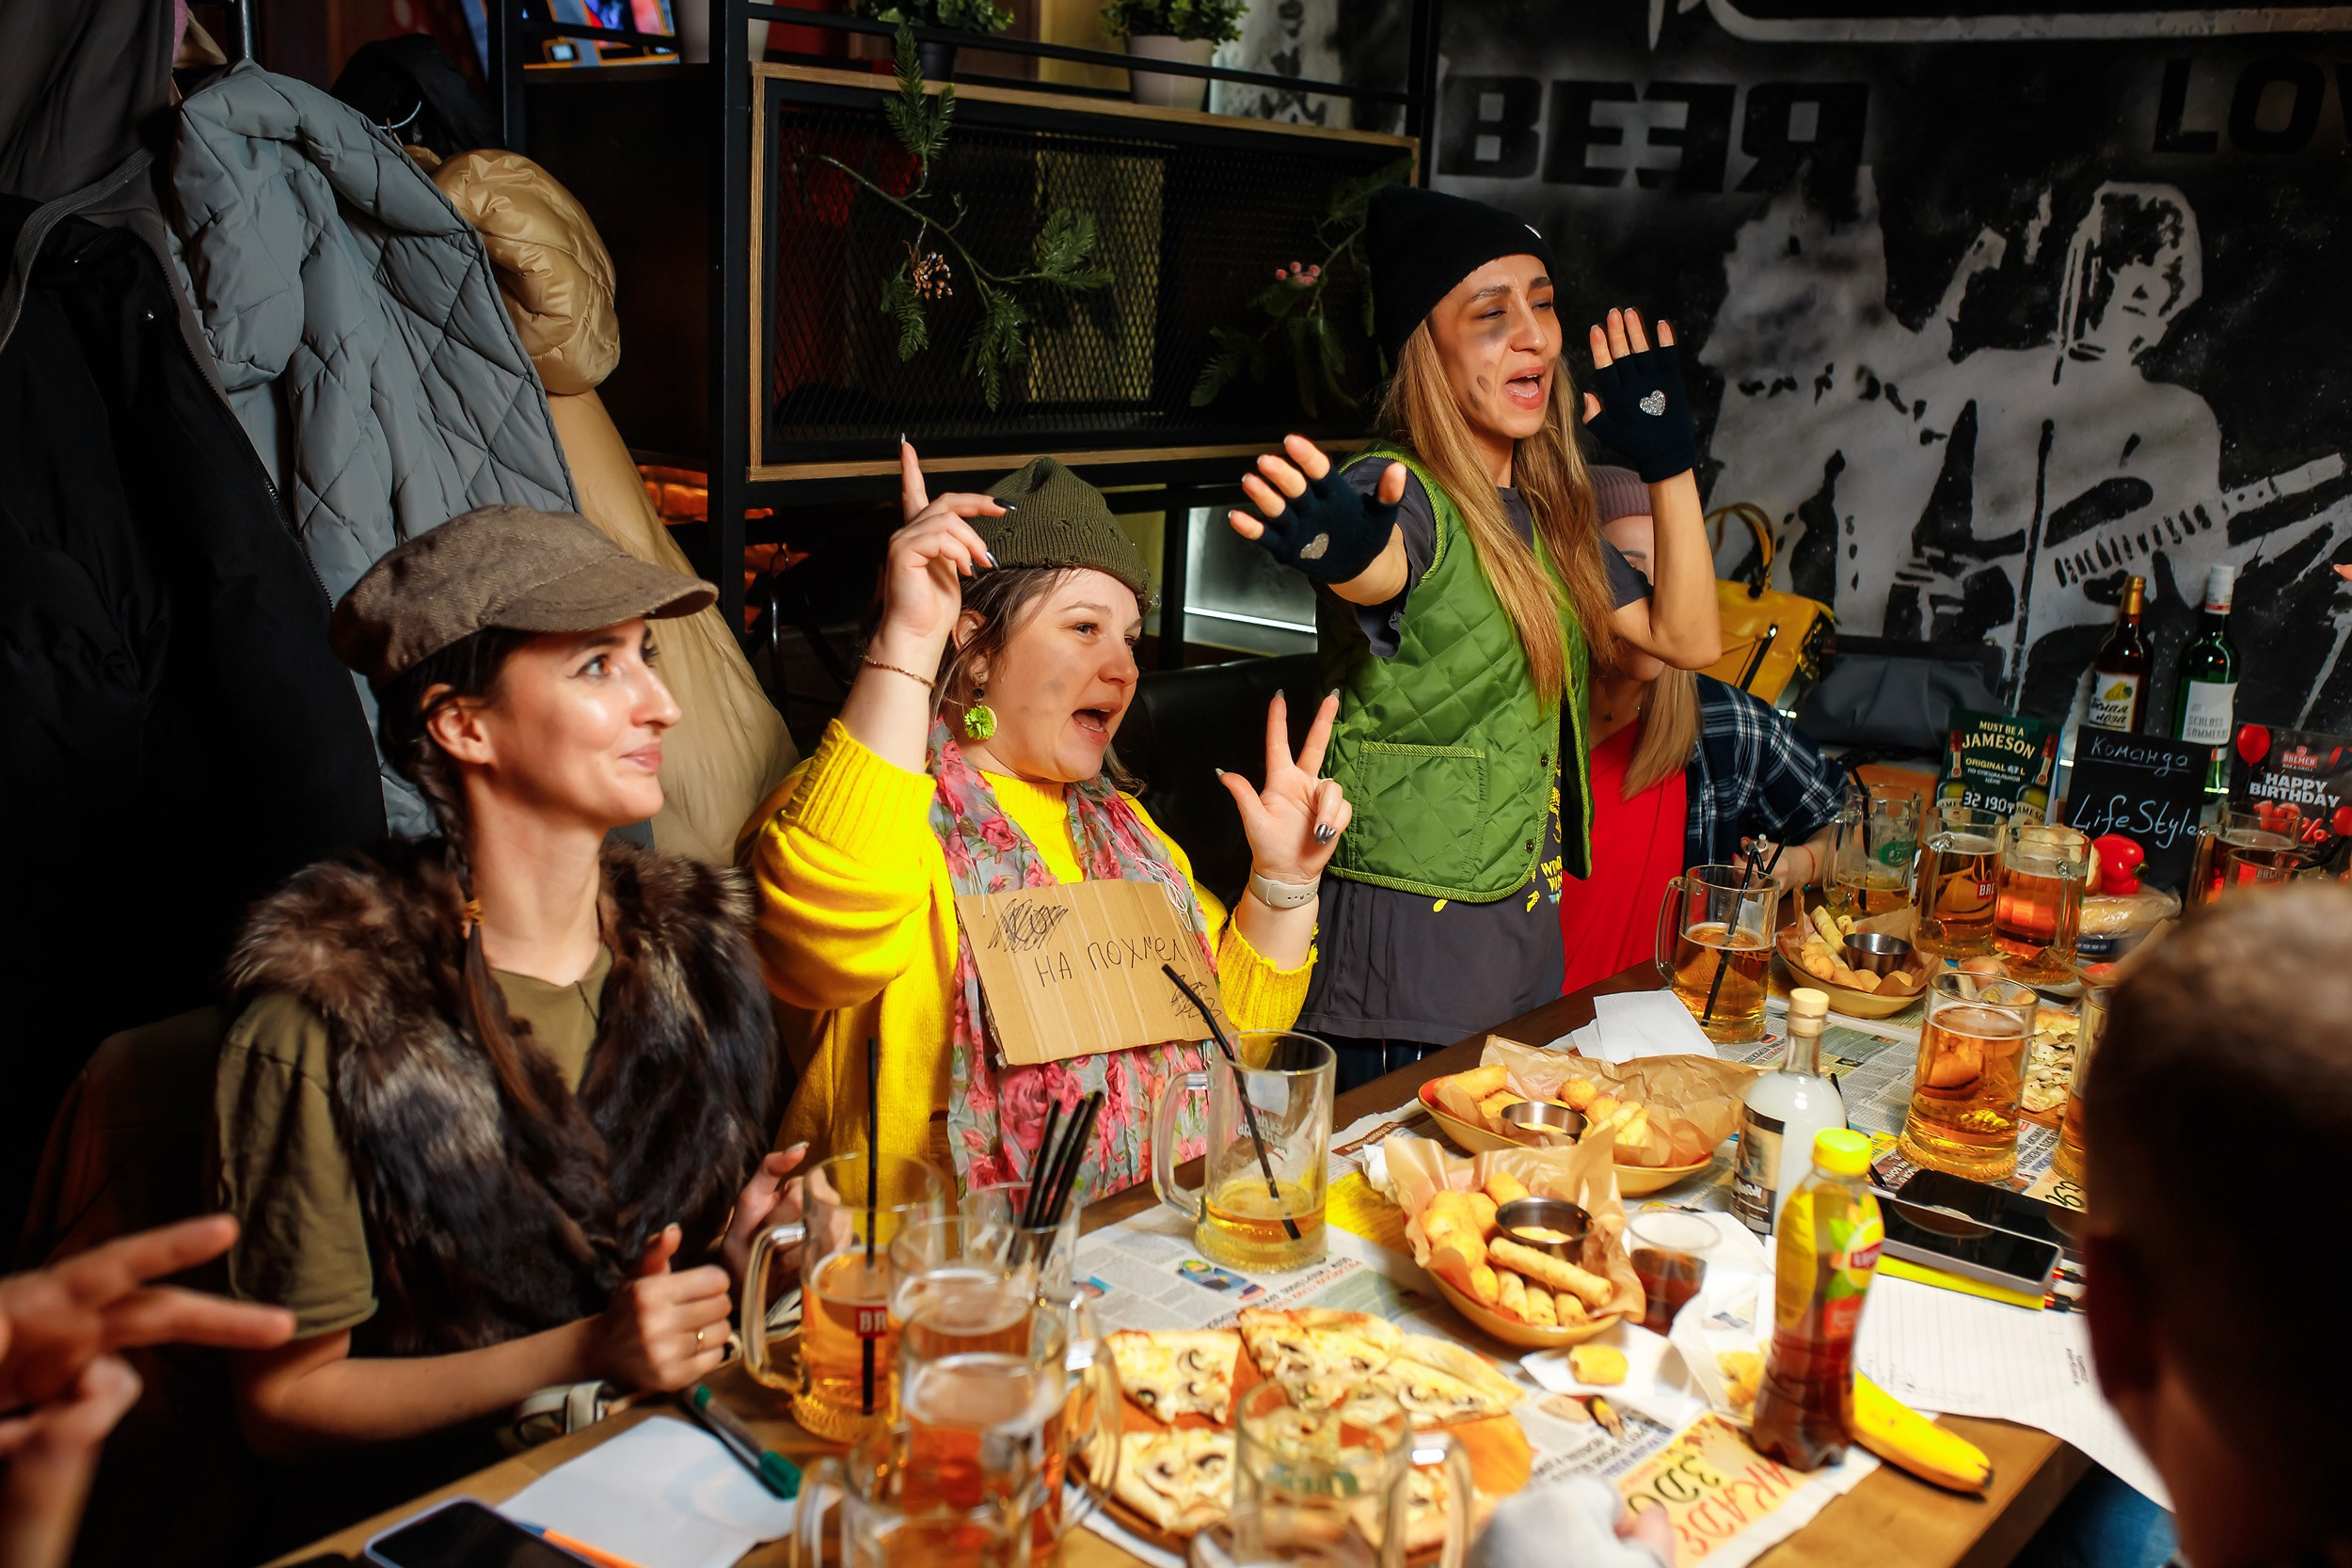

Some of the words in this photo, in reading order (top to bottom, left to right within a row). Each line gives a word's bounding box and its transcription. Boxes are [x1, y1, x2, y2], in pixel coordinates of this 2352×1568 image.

[1979, 721, 2004, 734] MUST
[2005, 724, 2016, 736] BE
[2017, 727, 2025, 737] A
[1962, 734, 2036, 760] JAMESON
[2091, 736, 2188, 777] Команда
[1965, 757, 2006, 772] ORIGINAL
[2020, 767, 2026, 776] L
[2283, 752, 2315, 766] BREMEN
[2265, 772, 2328, 793] HAPPY
[1963, 791, 1981, 808] 32
[2249, 783, 2341, 808] BIRTHDAY
[1034, 951, 1073, 988] НА
